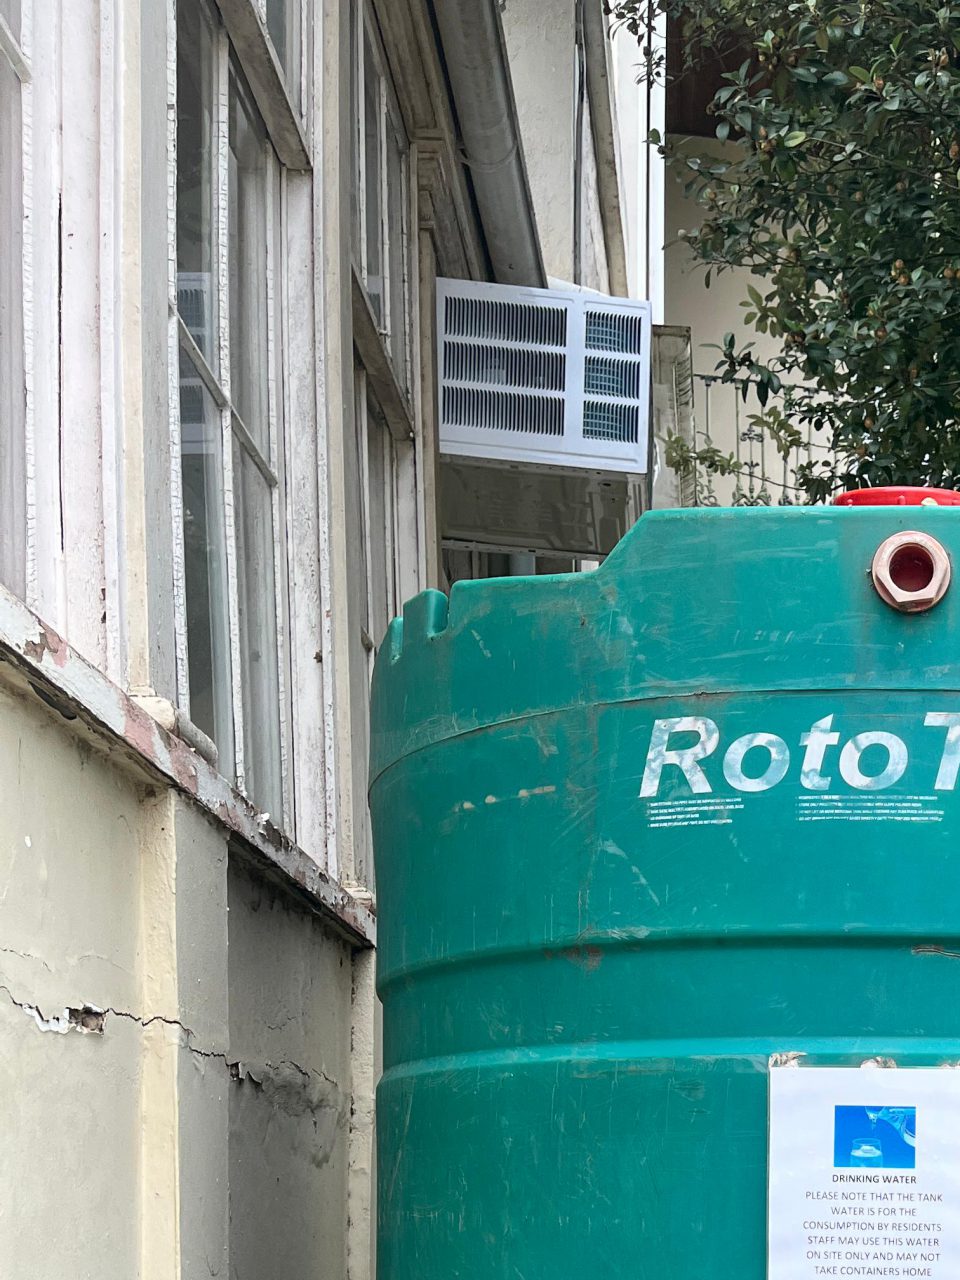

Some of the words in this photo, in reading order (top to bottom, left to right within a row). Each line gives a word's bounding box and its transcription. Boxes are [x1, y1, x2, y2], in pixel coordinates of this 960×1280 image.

[832, 1174, 879, 1183] DRINKING
[882, 1176, 916, 1184] WATER
[806, 1191, 838, 1200] PLEASE
[842, 1192, 867, 1200] NOTE
[897, 1193, 914, 1201] THE
[918, 1193, 942, 1202] TANK
[831, 1207, 864, 1215] WATER
[878, 1208, 896, 1216] FOR
[899, 1208, 916, 1216] THE
[803, 1221, 874, 1230] CONSUMPTION
[892, 1223, 941, 1231] RESIDENTS
[808, 1236, 835, 1244] STAFF
[838, 1237, 859, 1245] MAY
[862, 1237, 880, 1245] USE
[906, 1238, 940, 1246] WATER
[807, 1251, 820, 1259] ON
[824, 1251, 842, 1259] SITE
[845, 1252, 870, 1260] ONLY
[873, 1252, 893, 1260] AND
[896, 1253, 918, 1261] MAY
[921, 1253, 941, 1261] NOT
[815, 1266, 837, 1274] TAKE
[840, 1267, 899, 1275] CONTAINERS
[903, 1268, 932, 1276] HOME
